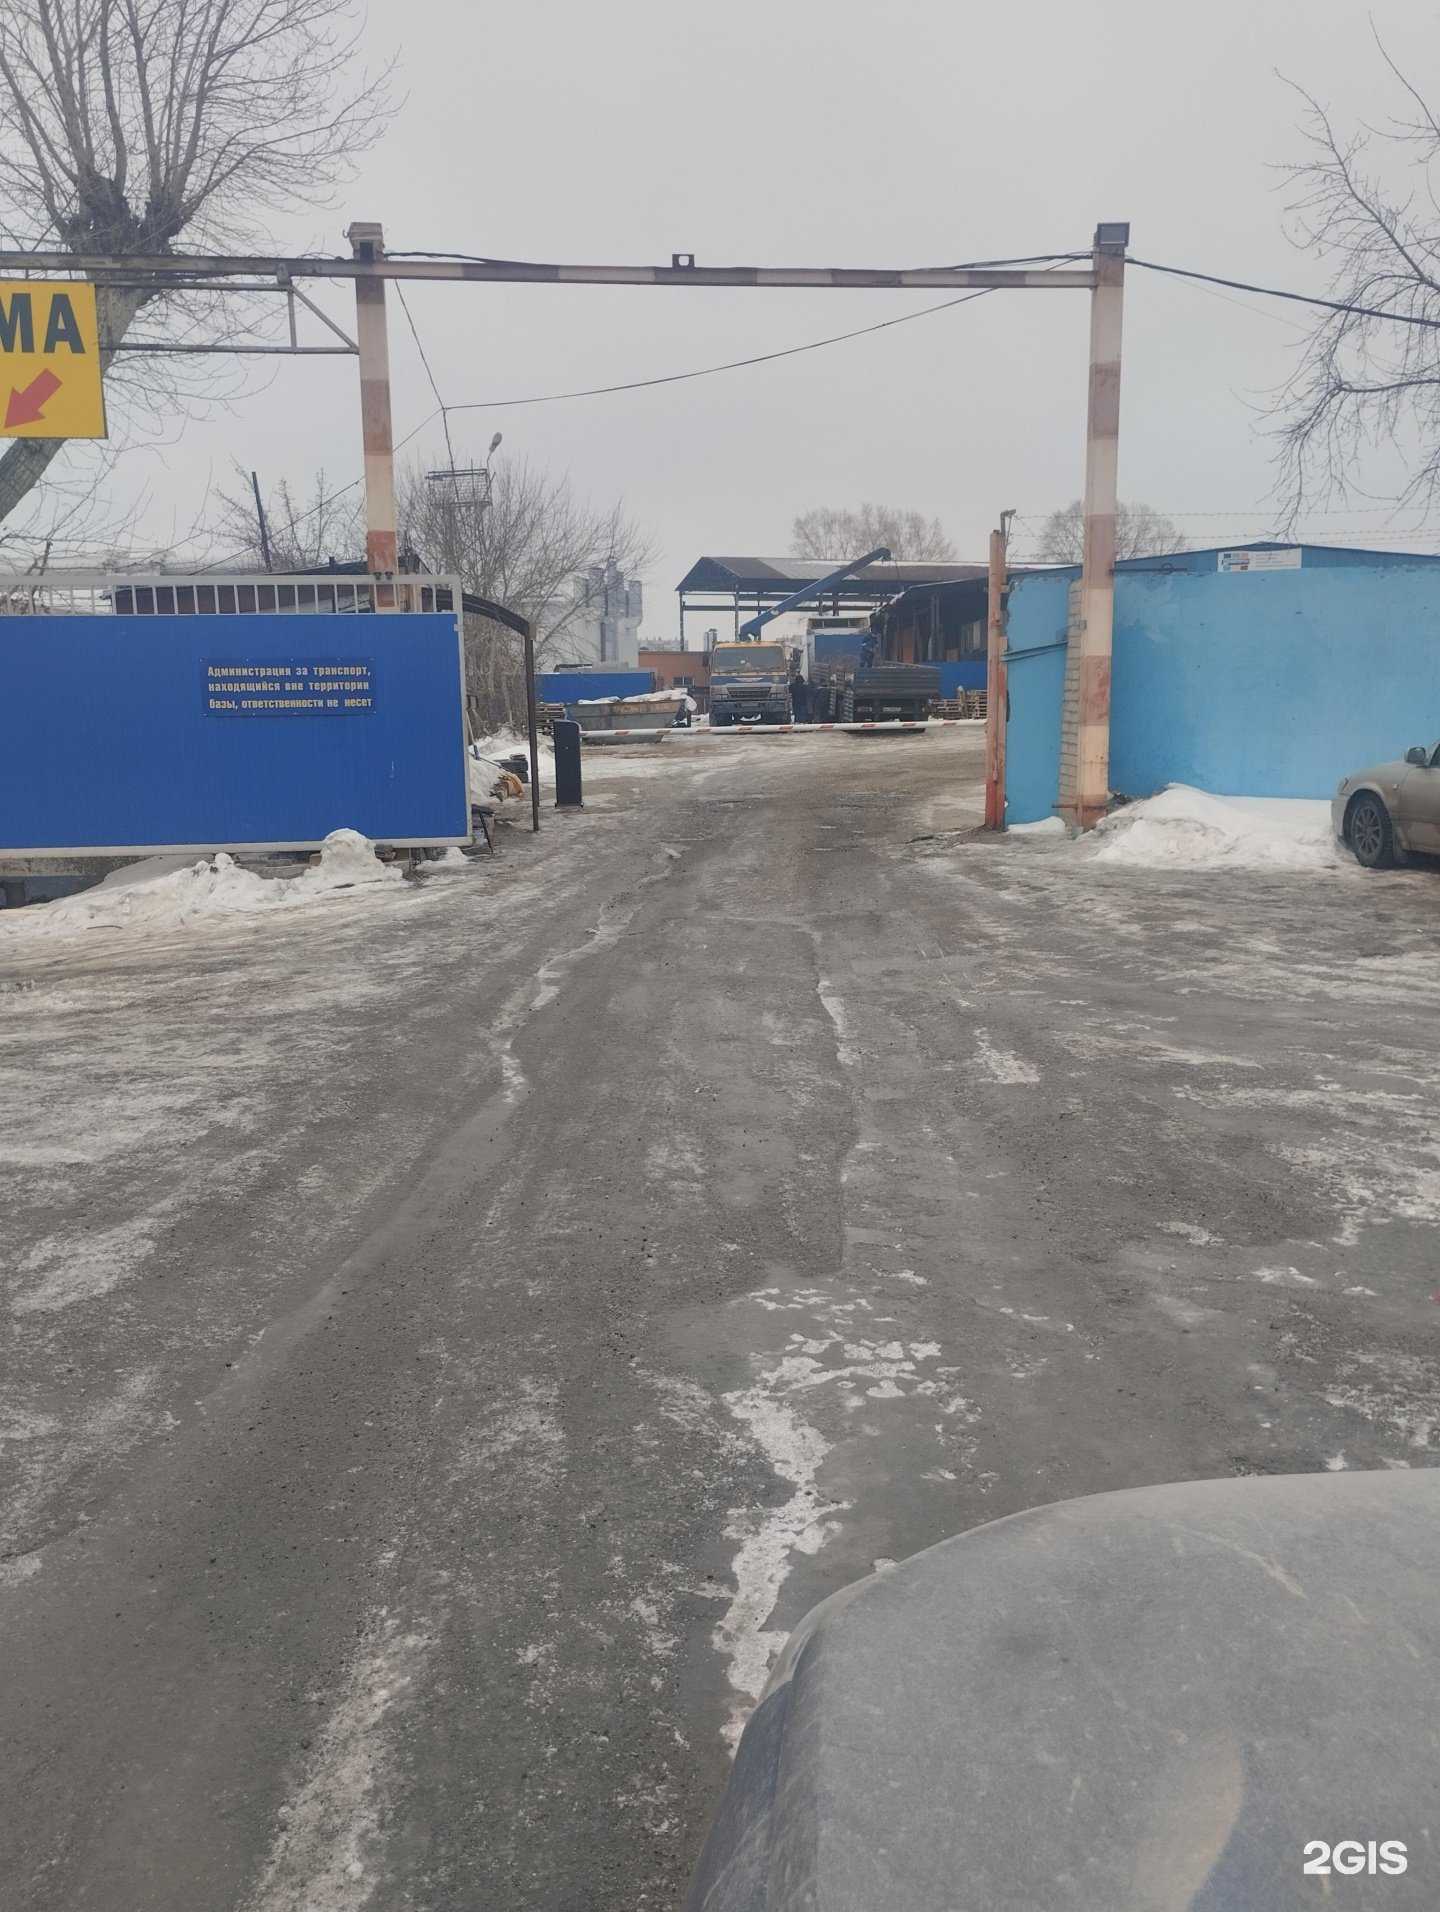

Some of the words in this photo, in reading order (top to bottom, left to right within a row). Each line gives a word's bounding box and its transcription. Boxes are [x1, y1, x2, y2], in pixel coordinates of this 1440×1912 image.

[207, 666, 291, 678] Администрация
[295, 666, 308, 676] за
[313, 665, 371, 677] транспорт,
[208, 681, 281, 692] находящийся
[285, 682, 304, 691] вне
[309, 681, 369, 692] территории
[209, 698, 238, 710] базы,
[241, 699, 324, 709] ответственности
[327, 698, 339, 708] не
[344, 697, 372, 708] несет
